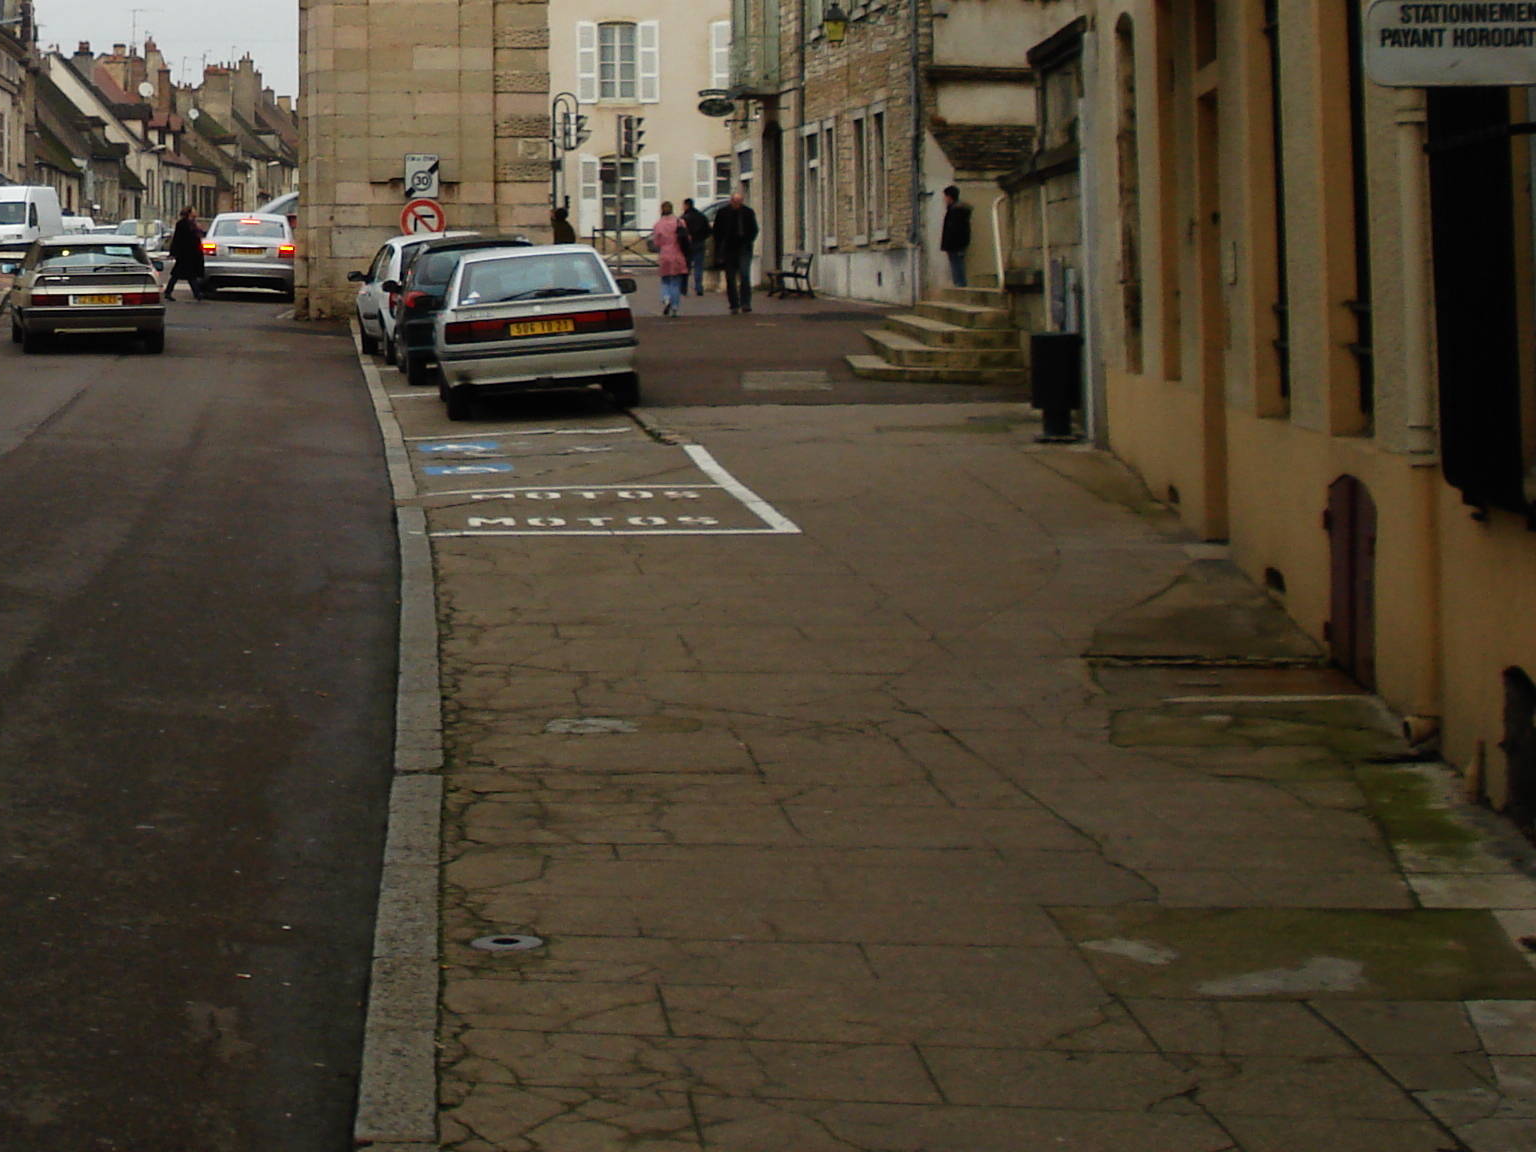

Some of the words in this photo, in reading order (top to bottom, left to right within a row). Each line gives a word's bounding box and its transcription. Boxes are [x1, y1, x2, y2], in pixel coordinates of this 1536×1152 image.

[1380, 27, 1447, 48] PAYANT
[1452, 27, 1536, 48] HORODAT
[415, 175, 429, 186] 30
[470, 491, 701, 500] MOTOS
[467, 517, 720, 527] MOTOS
